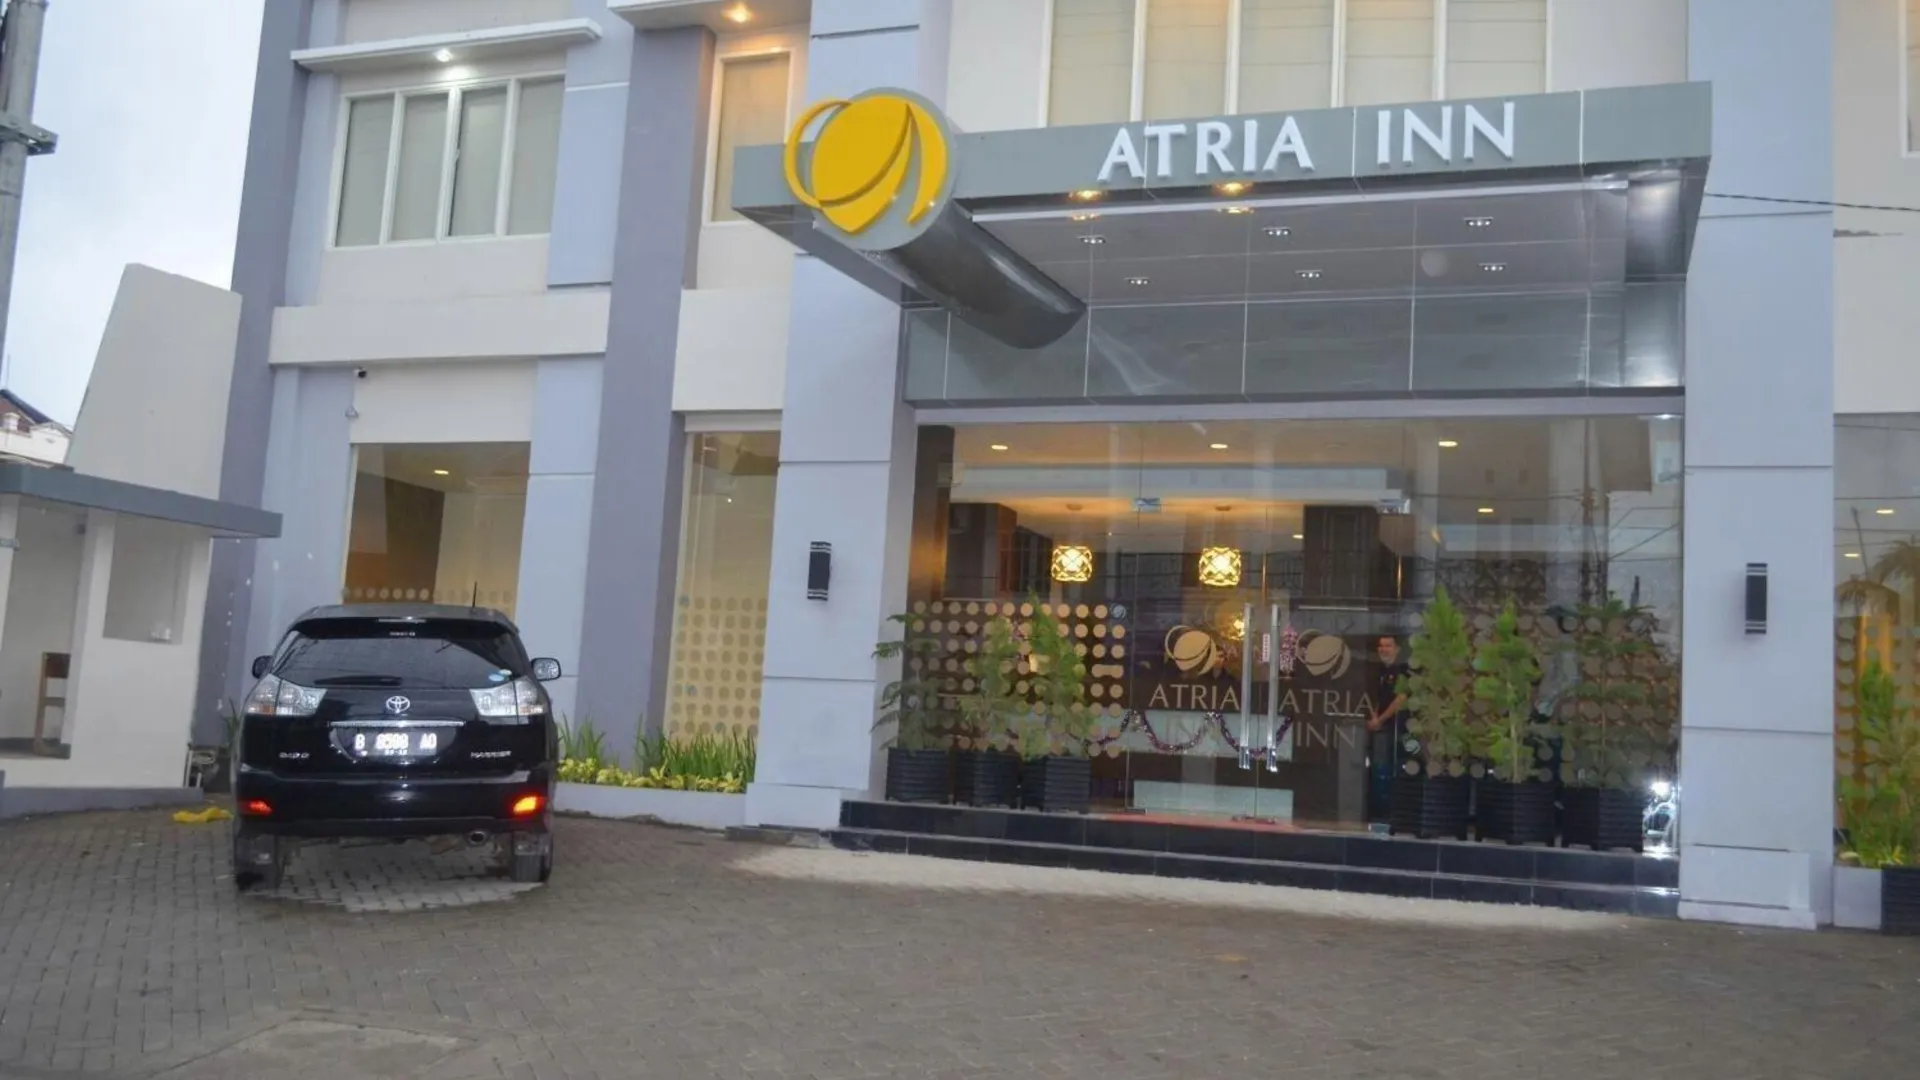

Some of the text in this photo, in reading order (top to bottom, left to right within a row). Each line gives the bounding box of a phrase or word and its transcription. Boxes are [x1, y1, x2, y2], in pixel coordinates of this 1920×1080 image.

[1097, 102, 1515, 182] ATRIA INN
[1149, 683, 1241, 711] ATRIA
[1278, 687, 1376, 716] ATRIA
[354, 733, 366, 751] B
[1294, 722, 1357, 749] INN
